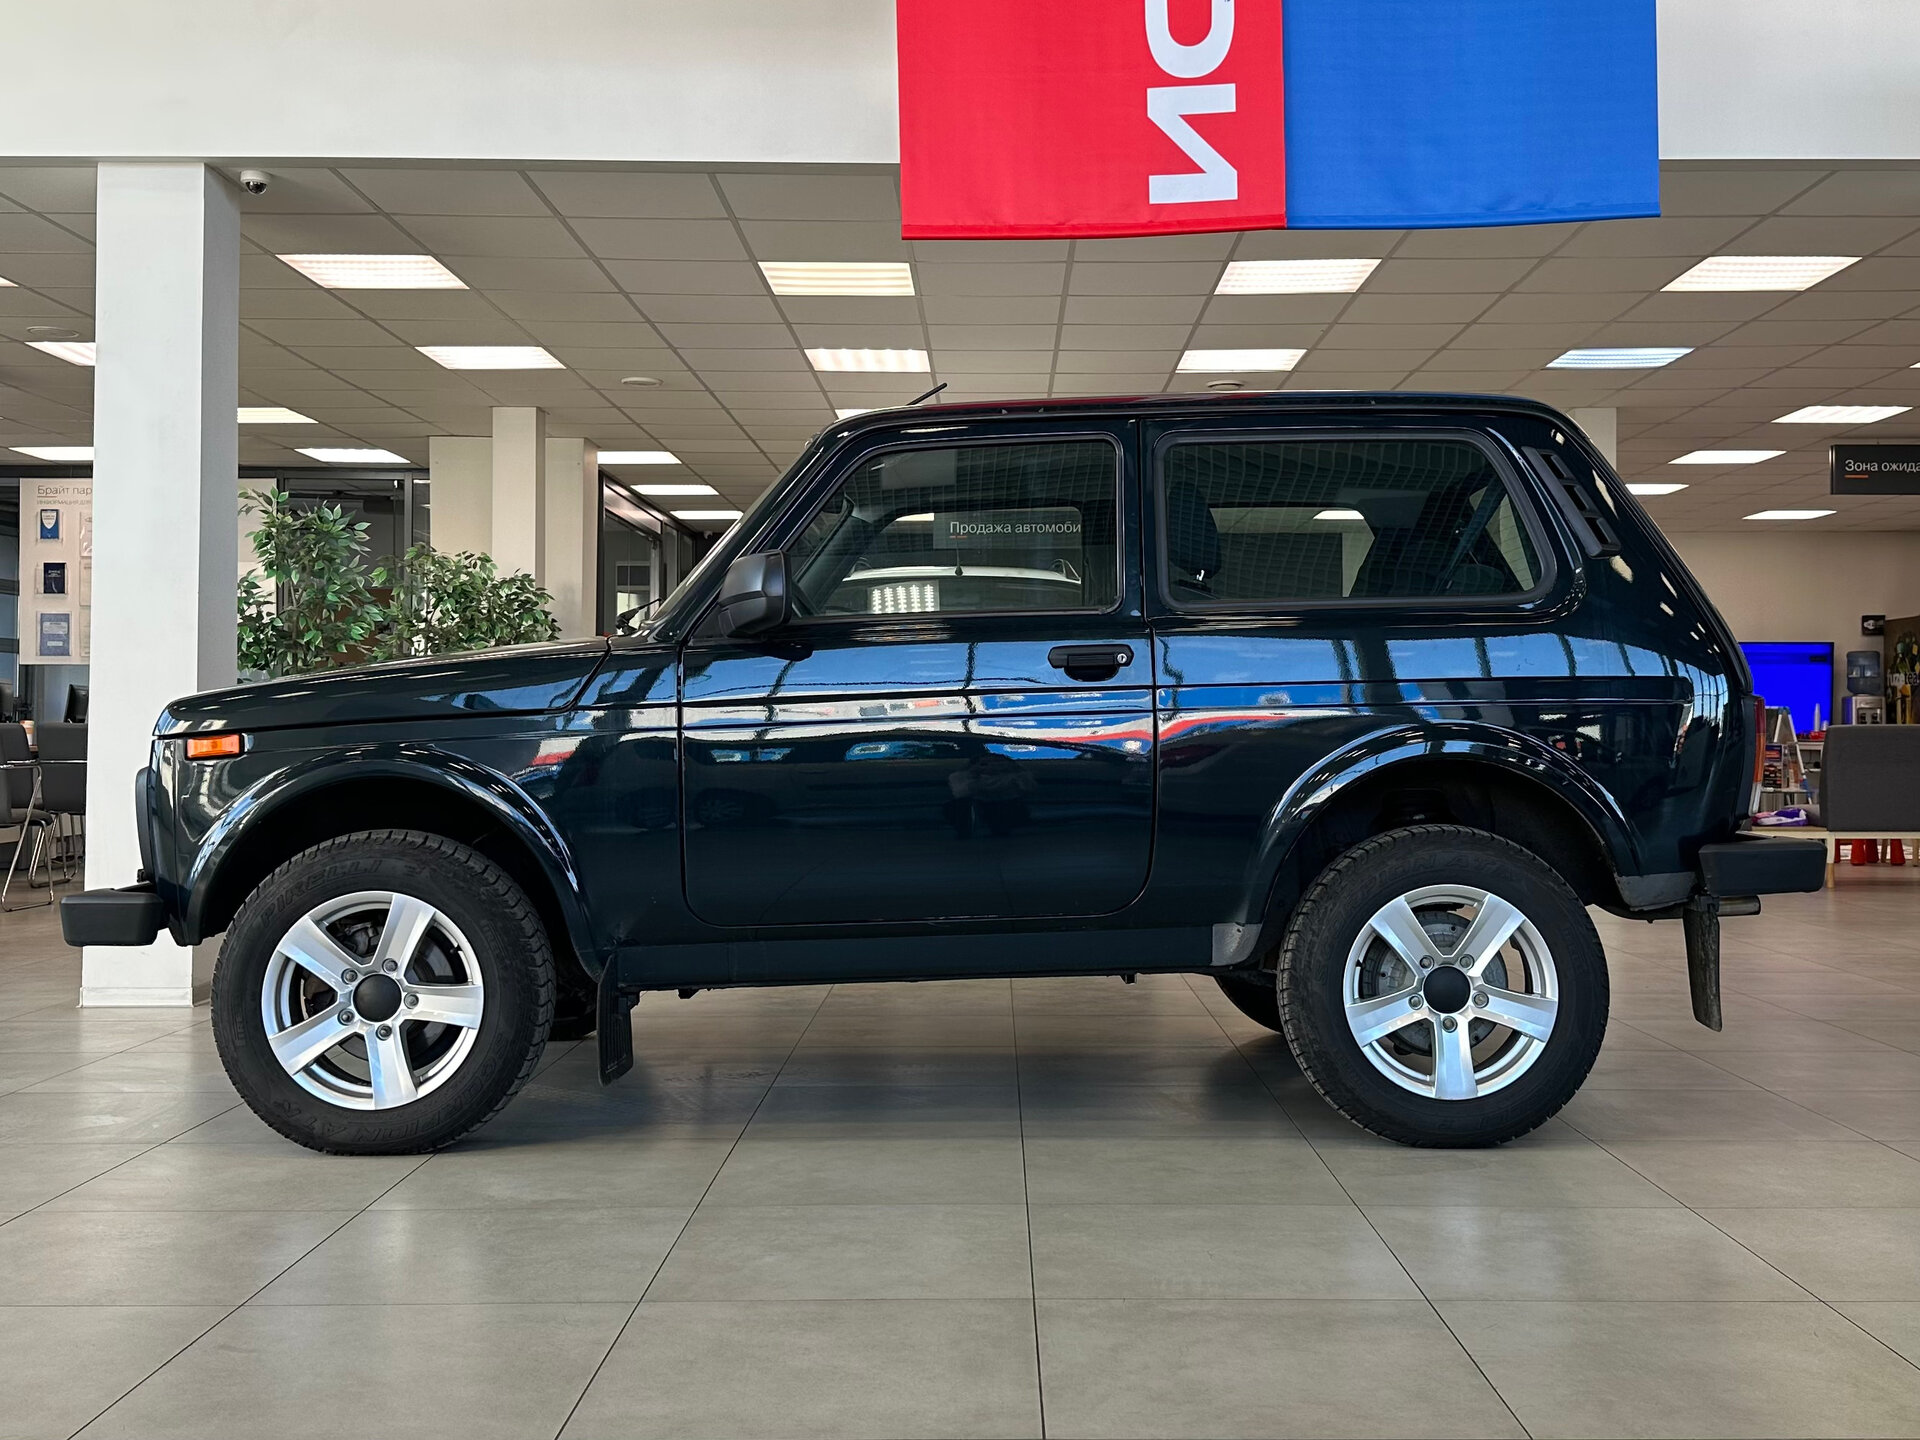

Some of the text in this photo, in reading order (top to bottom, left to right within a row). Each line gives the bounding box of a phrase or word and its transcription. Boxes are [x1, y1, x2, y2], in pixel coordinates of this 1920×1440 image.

[1845, 459, 1878, 472] Зона
[38, 485, 70, 495] Брайт
[950, 521, 1081, 535] Продажа автомоби
[260, 860, 382, 928] PIRELLI
